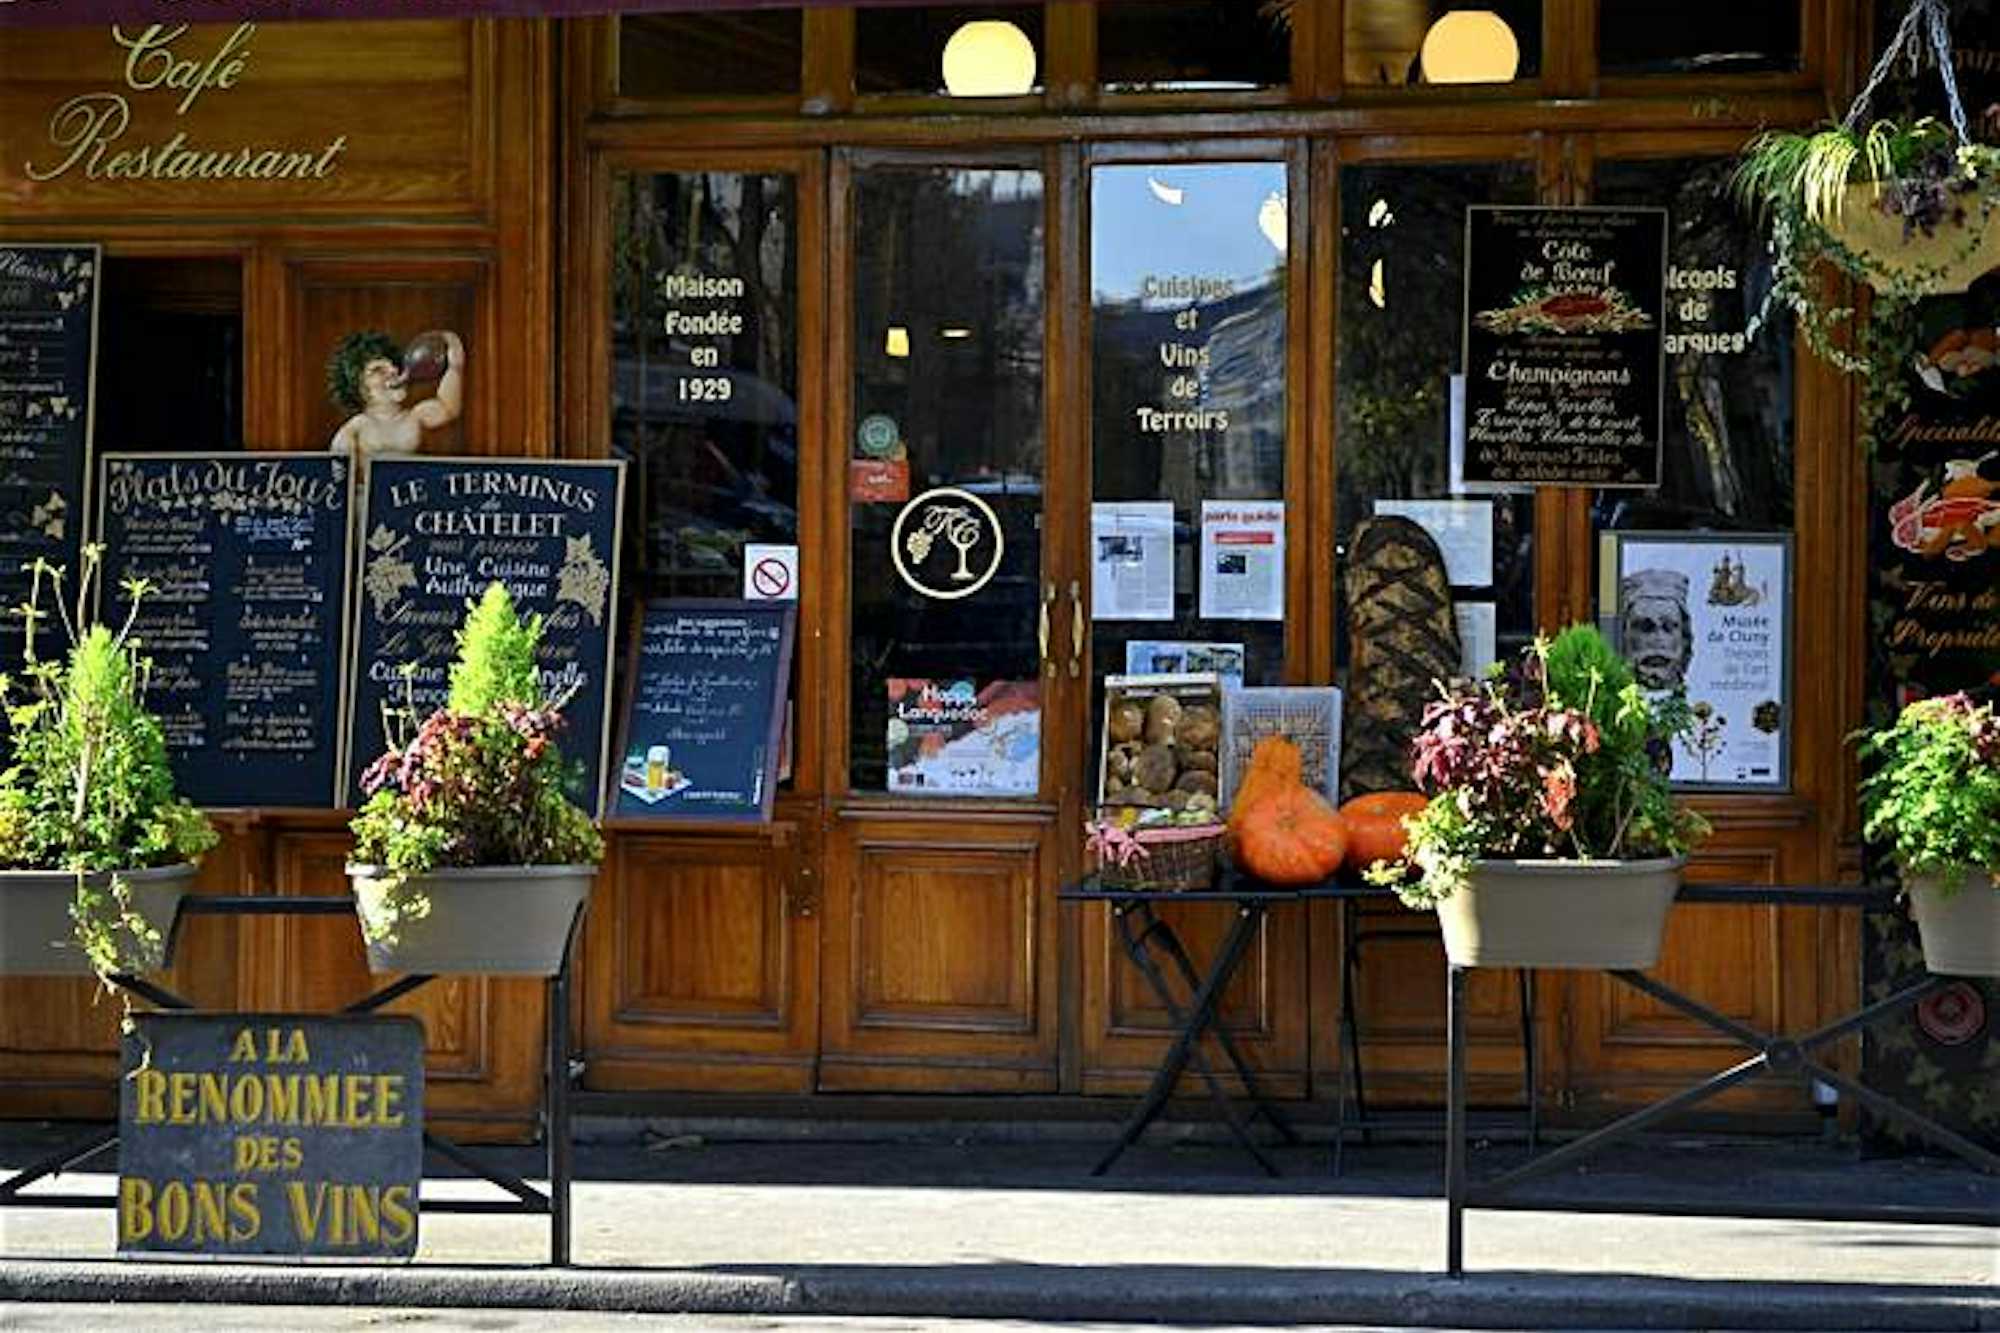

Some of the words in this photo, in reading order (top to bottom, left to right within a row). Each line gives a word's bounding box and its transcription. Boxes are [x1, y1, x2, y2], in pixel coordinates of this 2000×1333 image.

[112, 22, 257, 115] Café
[24, 93, 346, 181] Restaurant
[666, 272, 744, 299] Maison
[1665, 264, 1736, 290] lcools
[666, 309, 742, 335] Fondée
[1175, 307, 1199, 330] et
[1680, 297, 1708, 321] de
[1160, 341, 1211, 368] Vins
[1664, 332, 1745, 354] arques
[691, 346, 718, 367] en
[1487, 360, 1631, 390] Champignons
[680, 378, 731, 401] 1929
[1137, 407, 1229, 432] Terroirs
[253, 461, 342, 510] Jour
[390, 479, 428, 508] LE
[444, 471, 599, 513] TERMINUS
[425, 557, 466, 576] Une
[478, 557, 550, 578] Cuisine
[1722, 615, 1770, 628] Musée
[1708, 630, 1725, 643] de
[1729, 630, 1770, 646] Cluny
[897, 702, 990, 724] Languedoc
[229, 1028, 258, 1062] A
[266, 1028, 309, 1064] LA
[234, 1136, 304, 1171] DES
[121, 1176, 262, 1244] BONS
[286, 1180, 415, 1247] VINS
